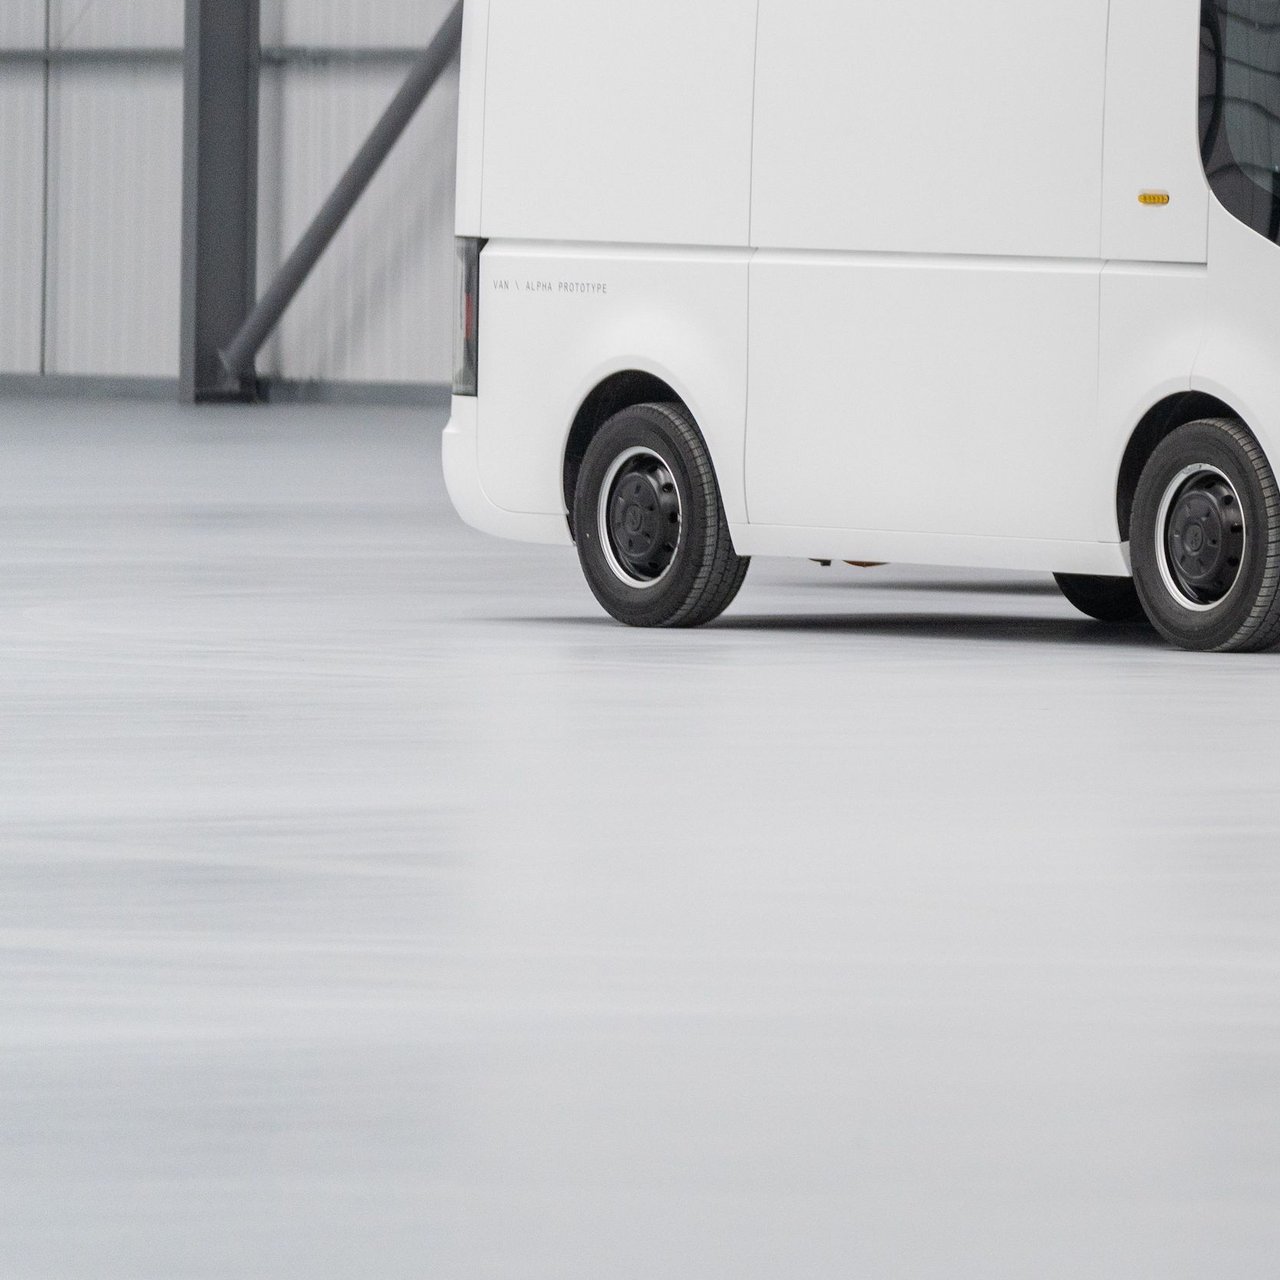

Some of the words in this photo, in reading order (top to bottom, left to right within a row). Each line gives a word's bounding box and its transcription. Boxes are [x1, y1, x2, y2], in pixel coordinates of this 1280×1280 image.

[492, 279, 511, 291] VAN
[525, 280, 554, 293] ALPHA
[558, 281, 608, 295] PROTOTYPE
